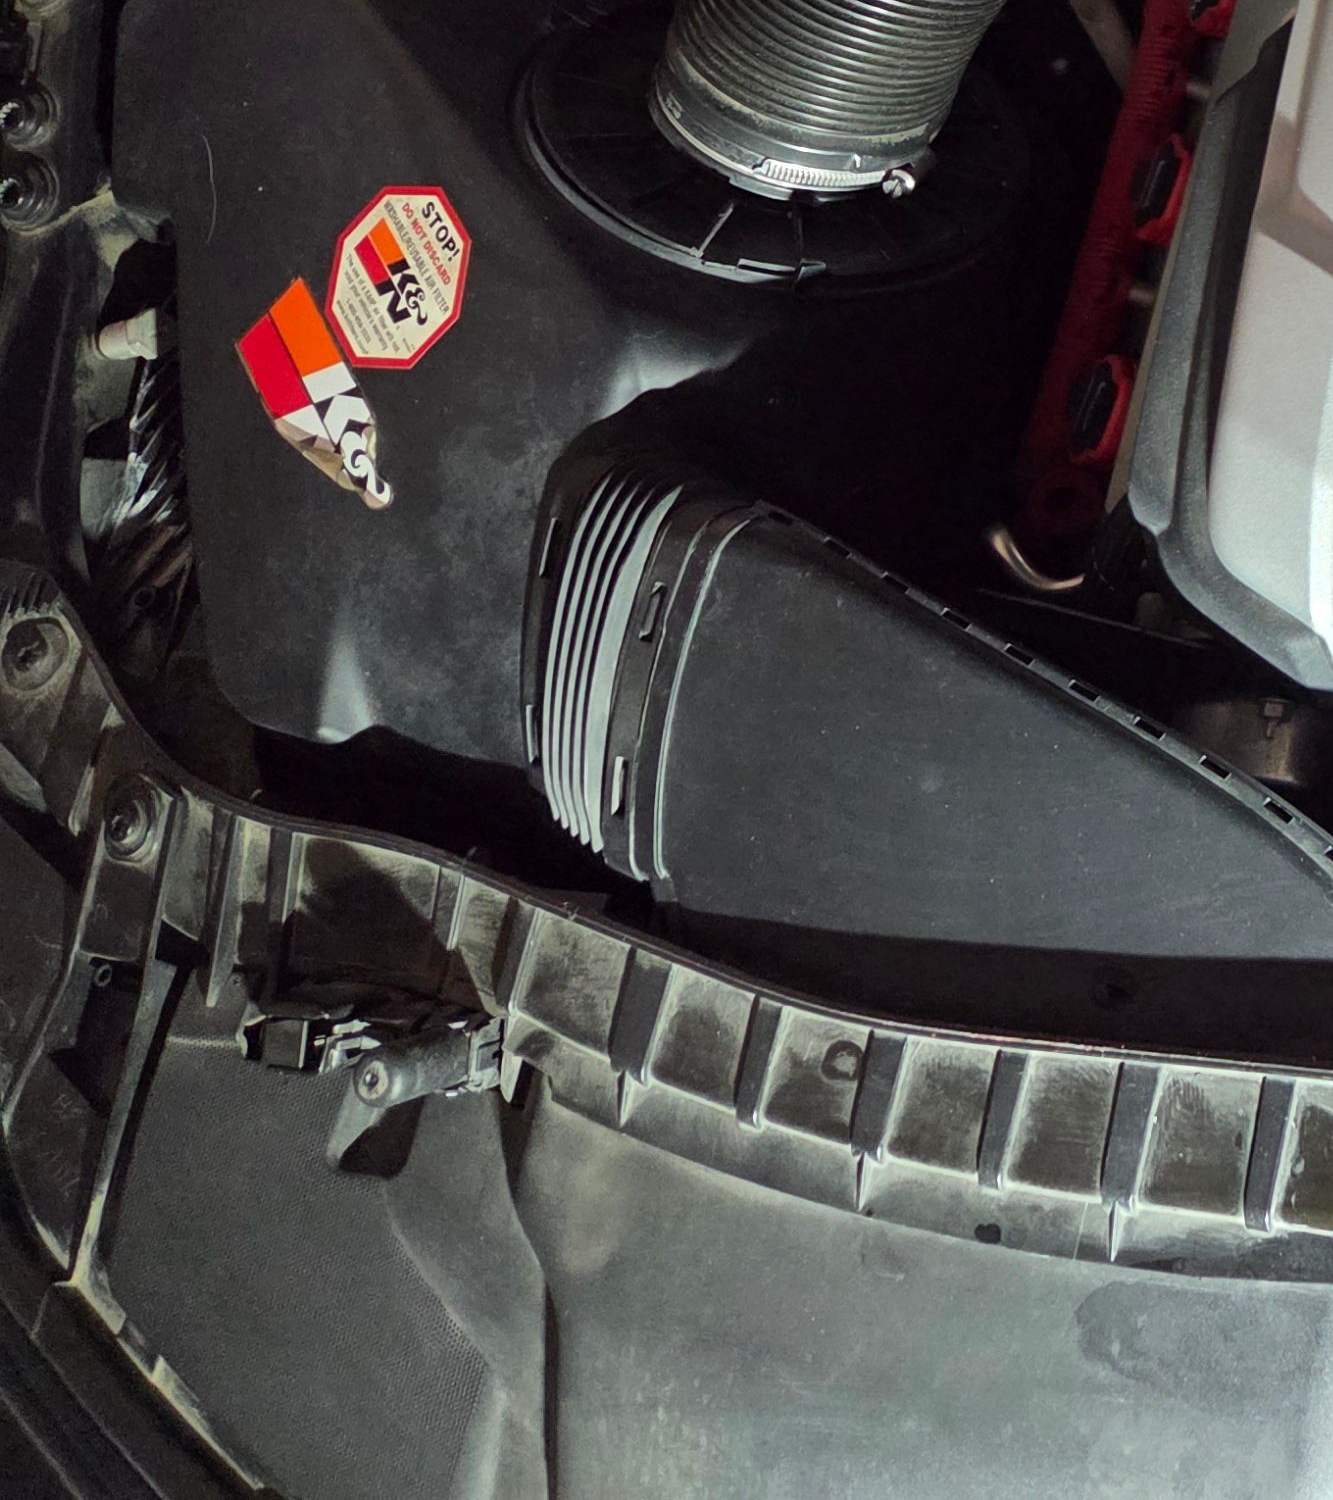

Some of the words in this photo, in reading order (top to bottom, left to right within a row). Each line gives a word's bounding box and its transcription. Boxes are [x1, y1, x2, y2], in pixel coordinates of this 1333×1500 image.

[402, 202, 415, 218] DO
[410, 218, 427, 242] NOT
[422, 241, 452, 286] DISCARD
[421, 201, 461, 262] STOP!
[423, 275, 437, 291] AIR
[431, 288, 450, 316] FILTER
